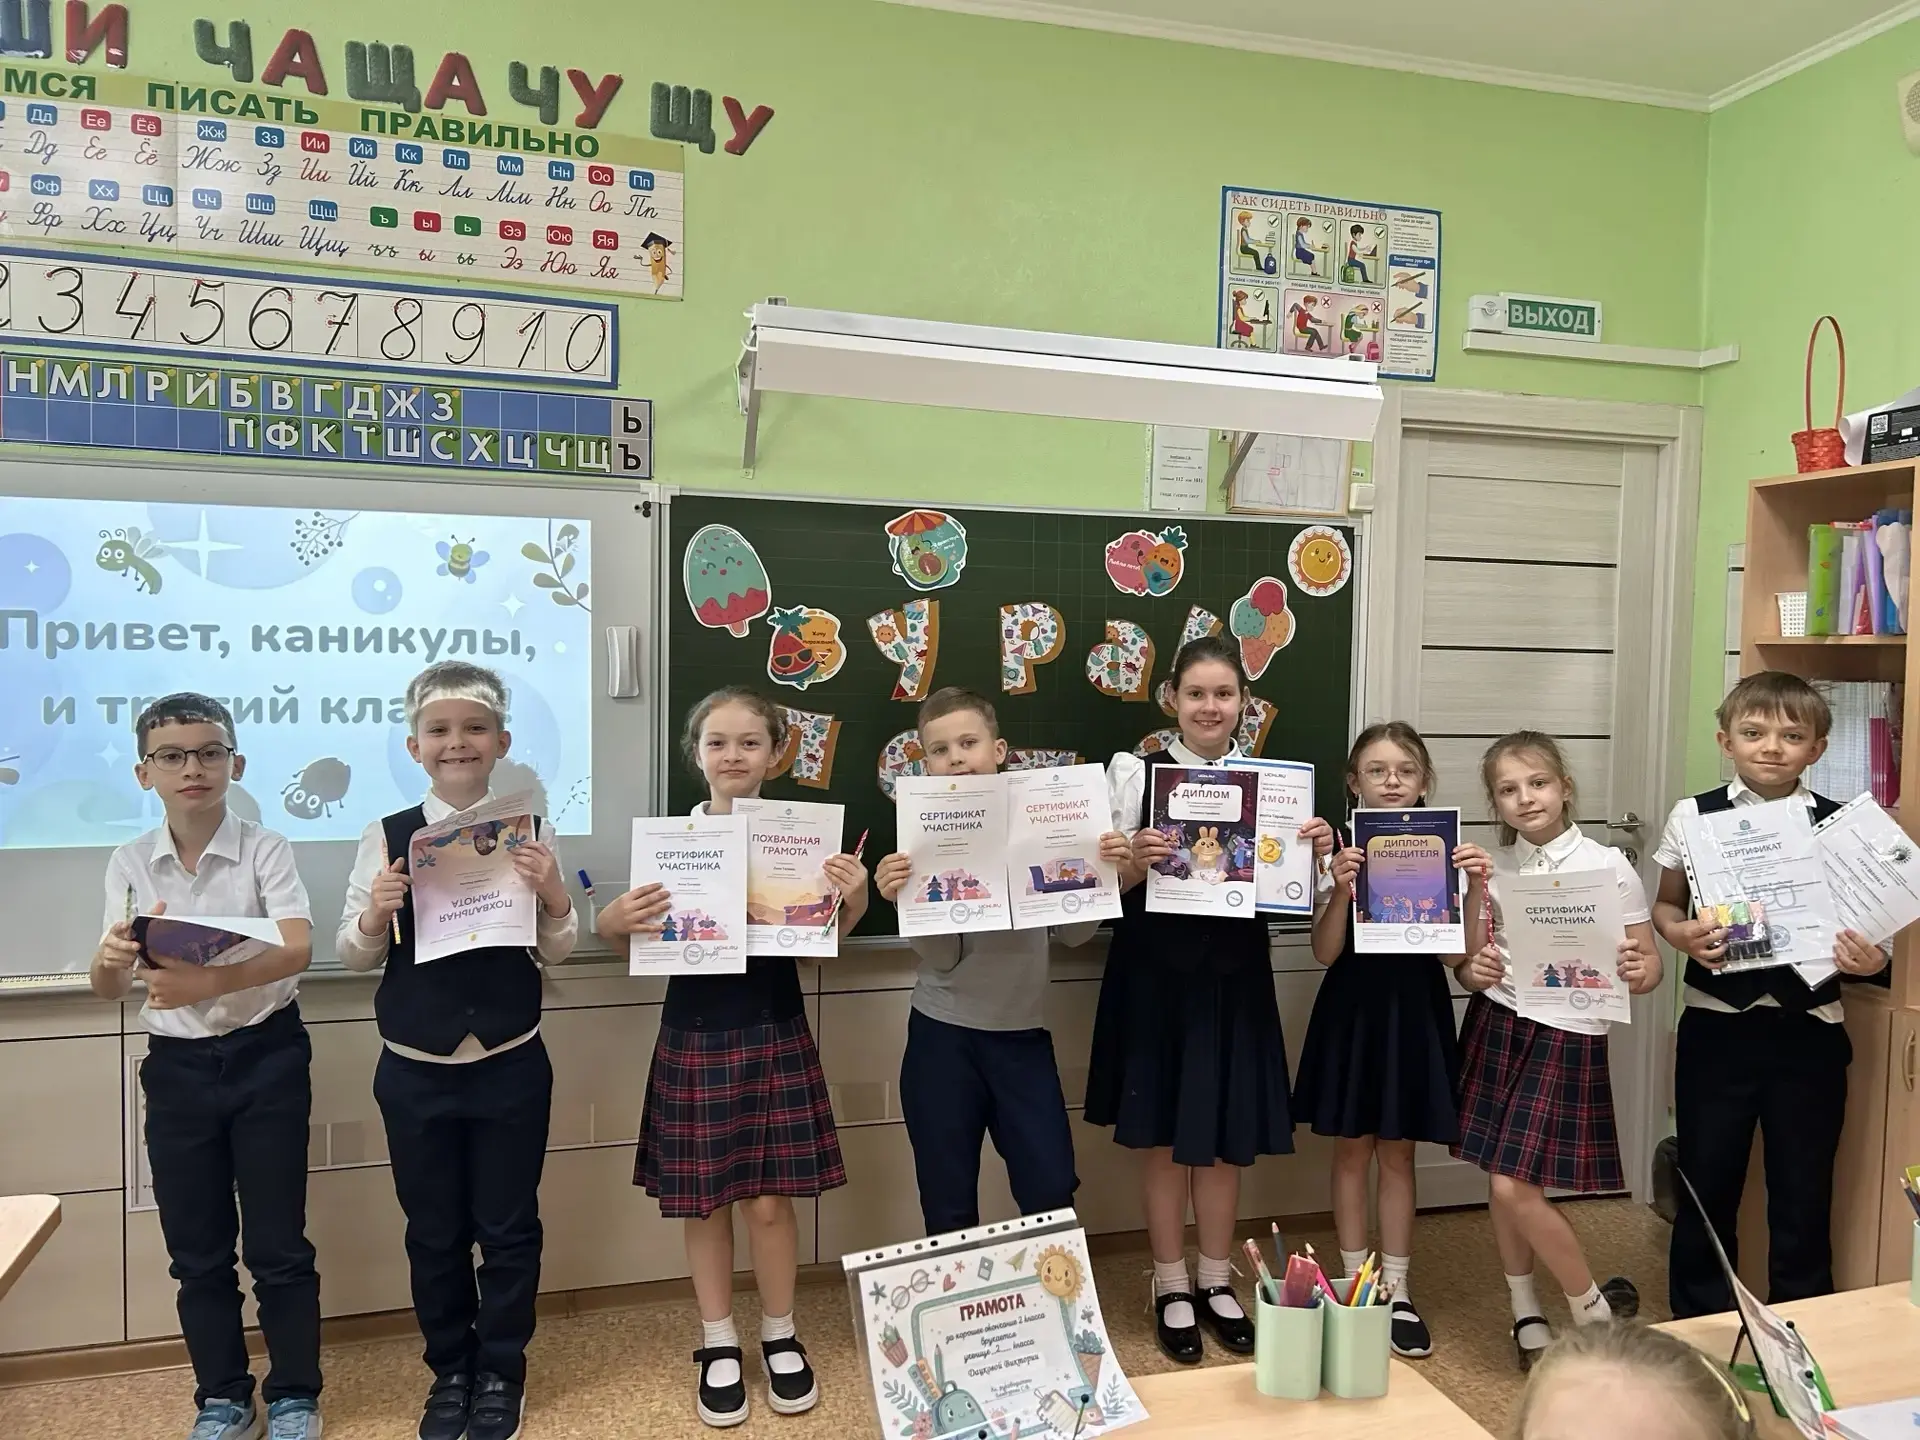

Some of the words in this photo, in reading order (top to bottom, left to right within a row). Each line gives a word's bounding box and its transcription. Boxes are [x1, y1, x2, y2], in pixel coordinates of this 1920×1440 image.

[193, 17, 328, 96] ЧА
[345, 40, 488, 117] ЩА
[508, 60, 624, 129] ЧУ
[650, 81, 775, 156] ЩУ
[5, 68, 96, 100] МСЯ
[147, 82, 320, 125] ПИСАТЬ
[360, 108, 600, 159] ПРАВИЛЬНО
[31, 108, 53, 124] Дд
[86, 113, 107, 128] Ее
[136, 117, 157, 133] Ёё
[199, 123, 226, 139] Жж
[261, 130, 279, 145] Зз
[305, 137, 327, 151] Ии
[353, 140, 374, 157] Йй
[401, 146, 418, 162] Кк
[445, 153, 467, 168] Лл
[500, 157, 522, 173] Мм
[551, 164, 571, 179] Нн
[592, 169, 612, 184] Оо
[633, 174, 651, 188] Пп
[1232, 195, 1257, 206] КАК
[1261, 198, 1311, 212] СИДЕТЬ
[1314, 204, 1387, 221] ПРАВИЛЬНО
[38, 267, 83, 333] 3
[115, 272, 156, 339] 4
[180, 280, 224, 345] 5
[249, 287, 293, 350] 6
[317, 291, 358, 354] 7
[381, 298, 422, 360] 8
[445, 303, 486, 364] 9
[518, 310, 607, 372] 10
[1510, 304, 1589, 333] ВЫХОД
[1, 608, 230, 660] Привет,
[251, 625, 537, 663] каникулы,
[43, 696, 76, 724] и
[96, 684, 299, 733] трий
[1182, 789, 1230, 799] ДИПЛОМ
[1260, 795, 1298, 804] АМОТА
[1026, 800, 1090, 813] СЕРТИФИКАТ
[920, 810, 986, 820] СЕРТИФИКАТ
[1030, 812, 1089, 825] УЧАСТНИКА
[923, 821, 983, 832] УЧАСТНИКА
[752, 834, 820, 845] ПОХВАЛЬНАЯ
[1384, 839, 1428, 848] ДИПЛОМ
[656, 850, 724, 859] СЕРТИФИКАТ
[763, 846, 808, 856] ГРАМОТА
[1373, 850, 1439, 859] ПОБЕДИТЕЛЯ
[1721, 842, 1782, 859] СЕРТИФИКАТ
[658, 862, 721, 870] УЧАСТНИКА
[451, 890, 500, 907] ГРАМОТА
[439, 899, 513, 923] ПОХВАЛЬНАЯ
[1525, 904, 1596, 914] СЕРТИФИКАТ
[1530, 916, 1596, 924] УЧАСТНИКА
[960, 1293, 1026, 1321] ГРАМОТА
